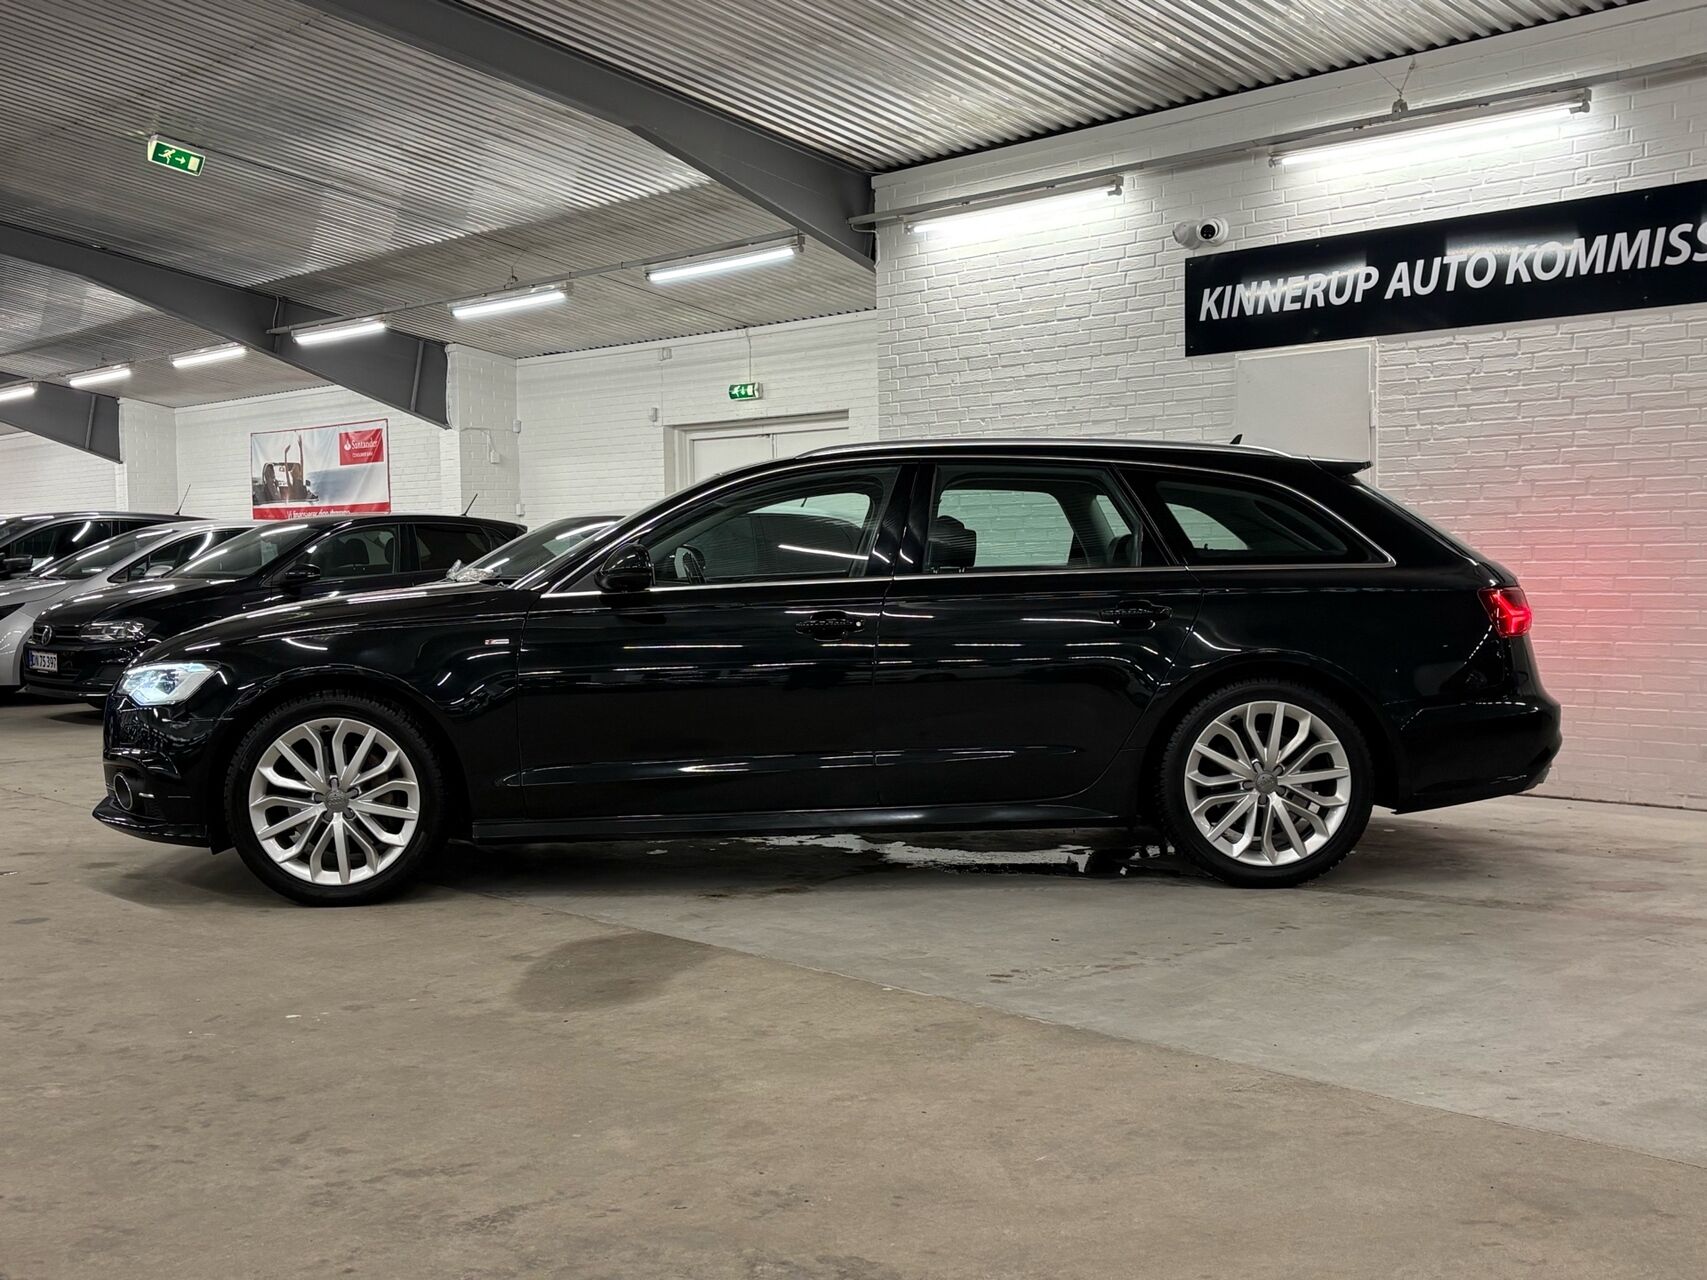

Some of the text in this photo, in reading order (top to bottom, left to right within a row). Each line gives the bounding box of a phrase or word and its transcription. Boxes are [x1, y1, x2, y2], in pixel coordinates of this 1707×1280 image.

[1199, 267, 1379, 321] KINNERUP
[1384, 253, 1496, 300] AUTO
[351, 437, 377, 450] Santander
